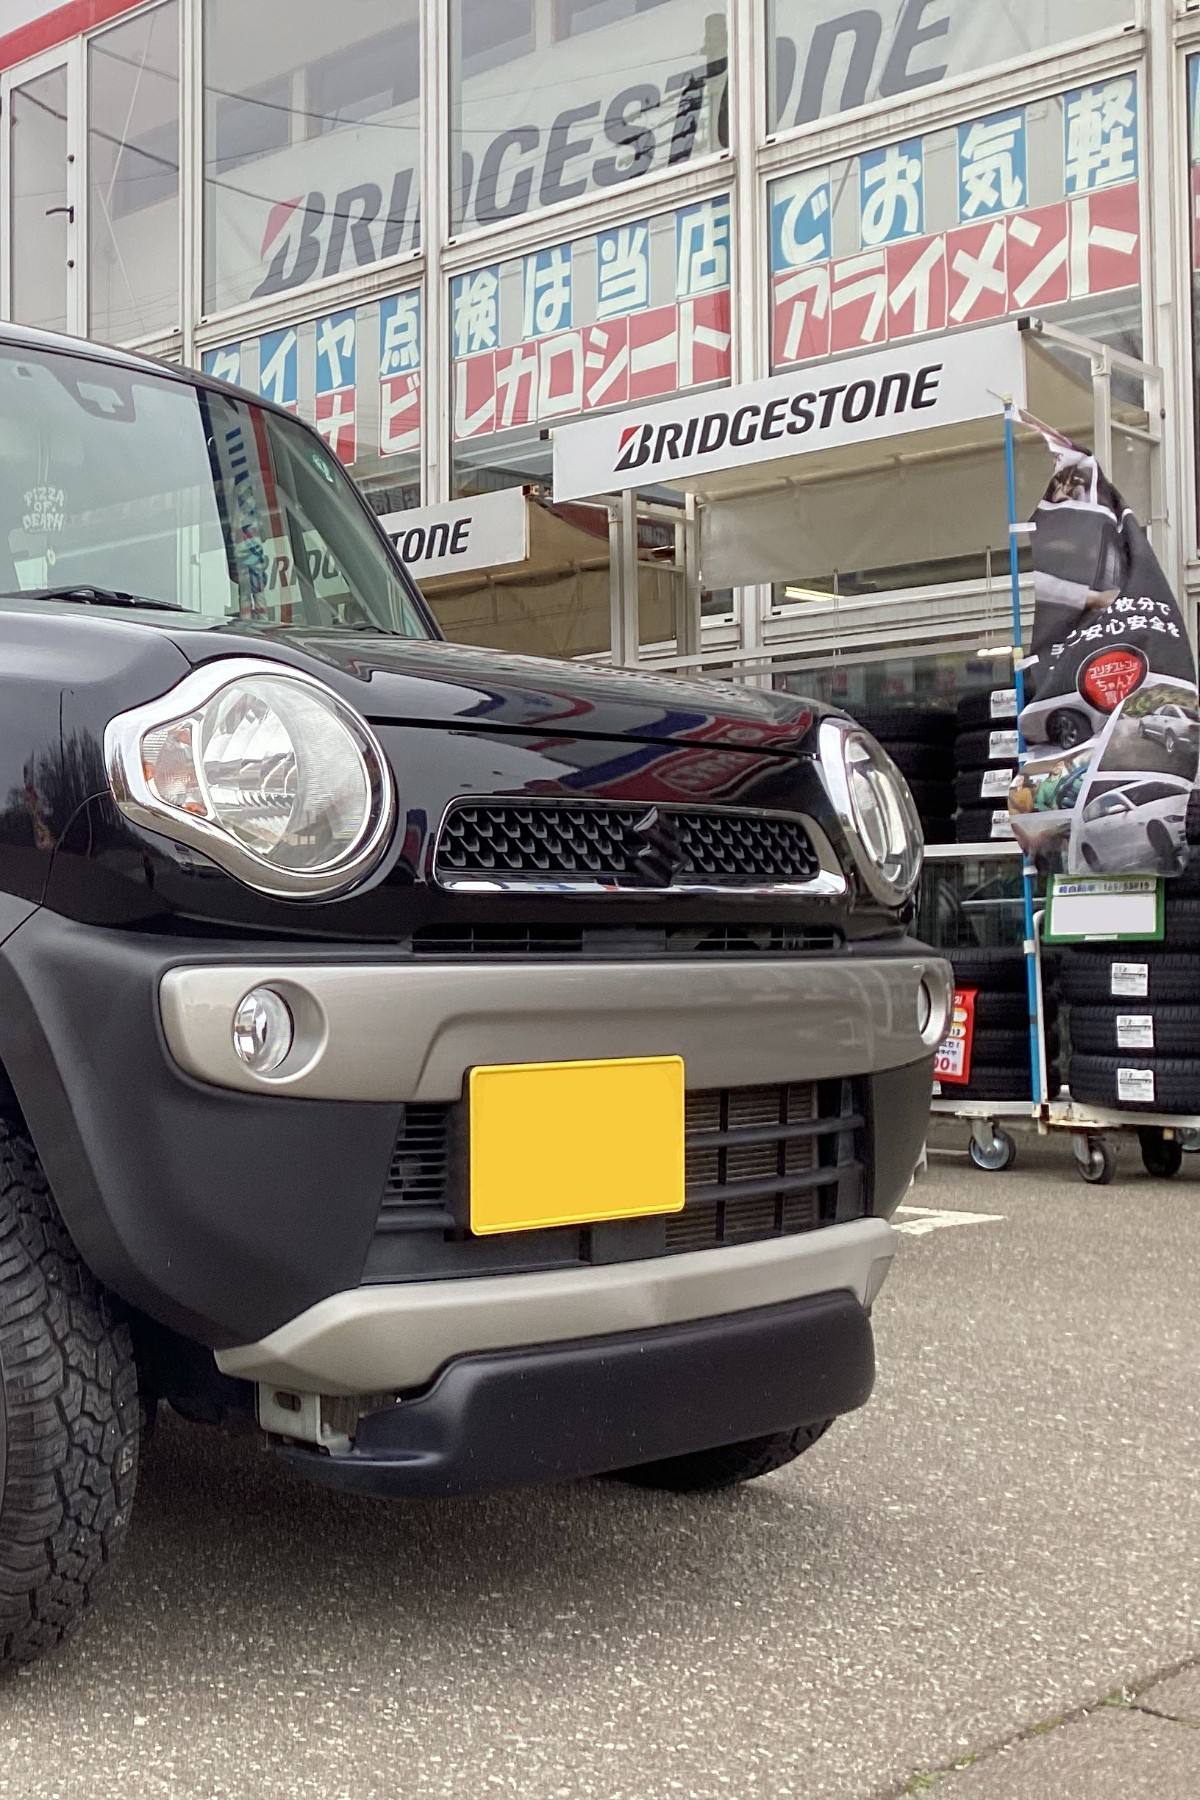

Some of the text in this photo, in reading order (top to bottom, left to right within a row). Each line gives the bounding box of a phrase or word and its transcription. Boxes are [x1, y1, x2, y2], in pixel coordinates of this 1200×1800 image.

[614, 362, 944, 472] BRIDGESTONE
[23, 486, 65, 508] PIZZA
[22, 512, 65, 532] DEATH
